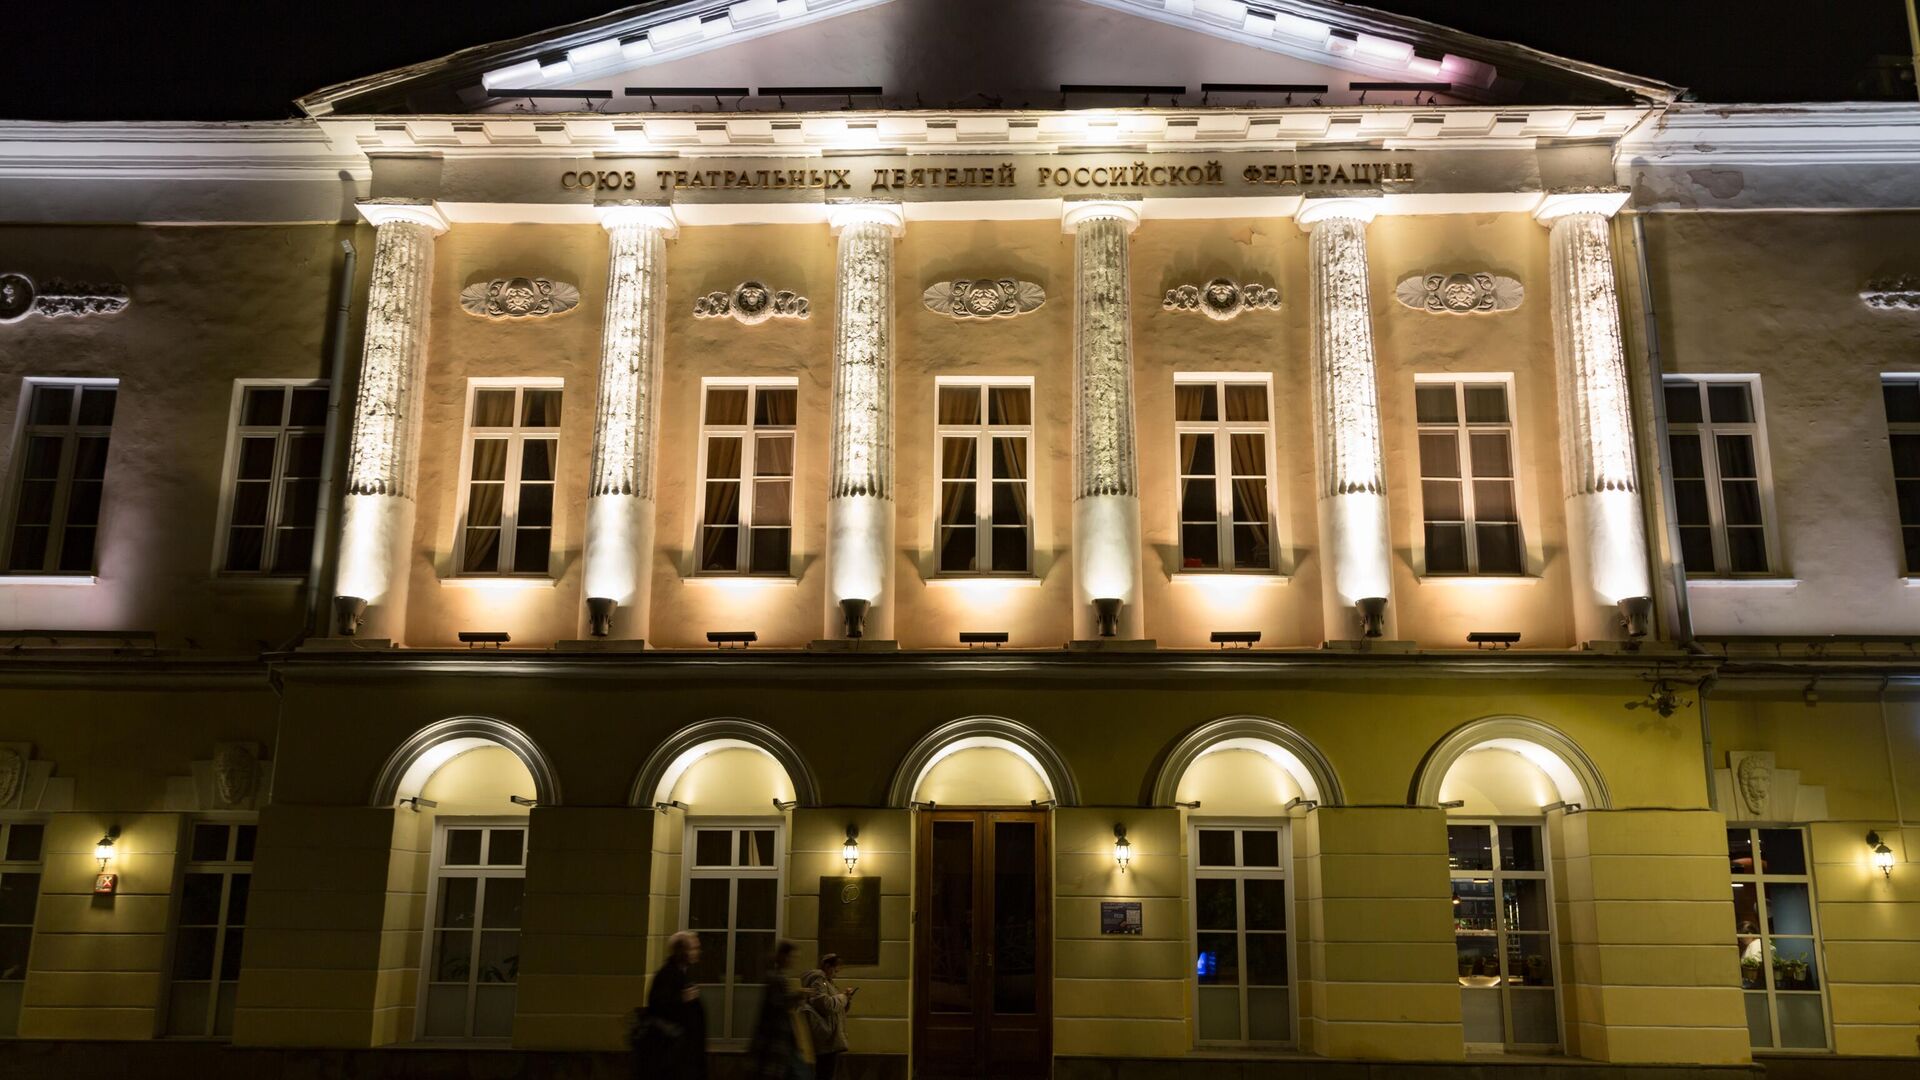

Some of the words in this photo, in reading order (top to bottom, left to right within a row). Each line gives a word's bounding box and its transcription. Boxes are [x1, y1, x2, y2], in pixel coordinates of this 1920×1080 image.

[561, 170, 636, 190] СОЮЗ
[657, 168, 851, 190] ТЕАТРАЛЬНЫХ
[871, 162, 1016, 190] ДЕЯТЕЛЕЙ
[1038, 161, 1224, 187] РОССИЙСКОЙ
[1243, 162, 1415, 186] ФЕДЕРАЦИИ
